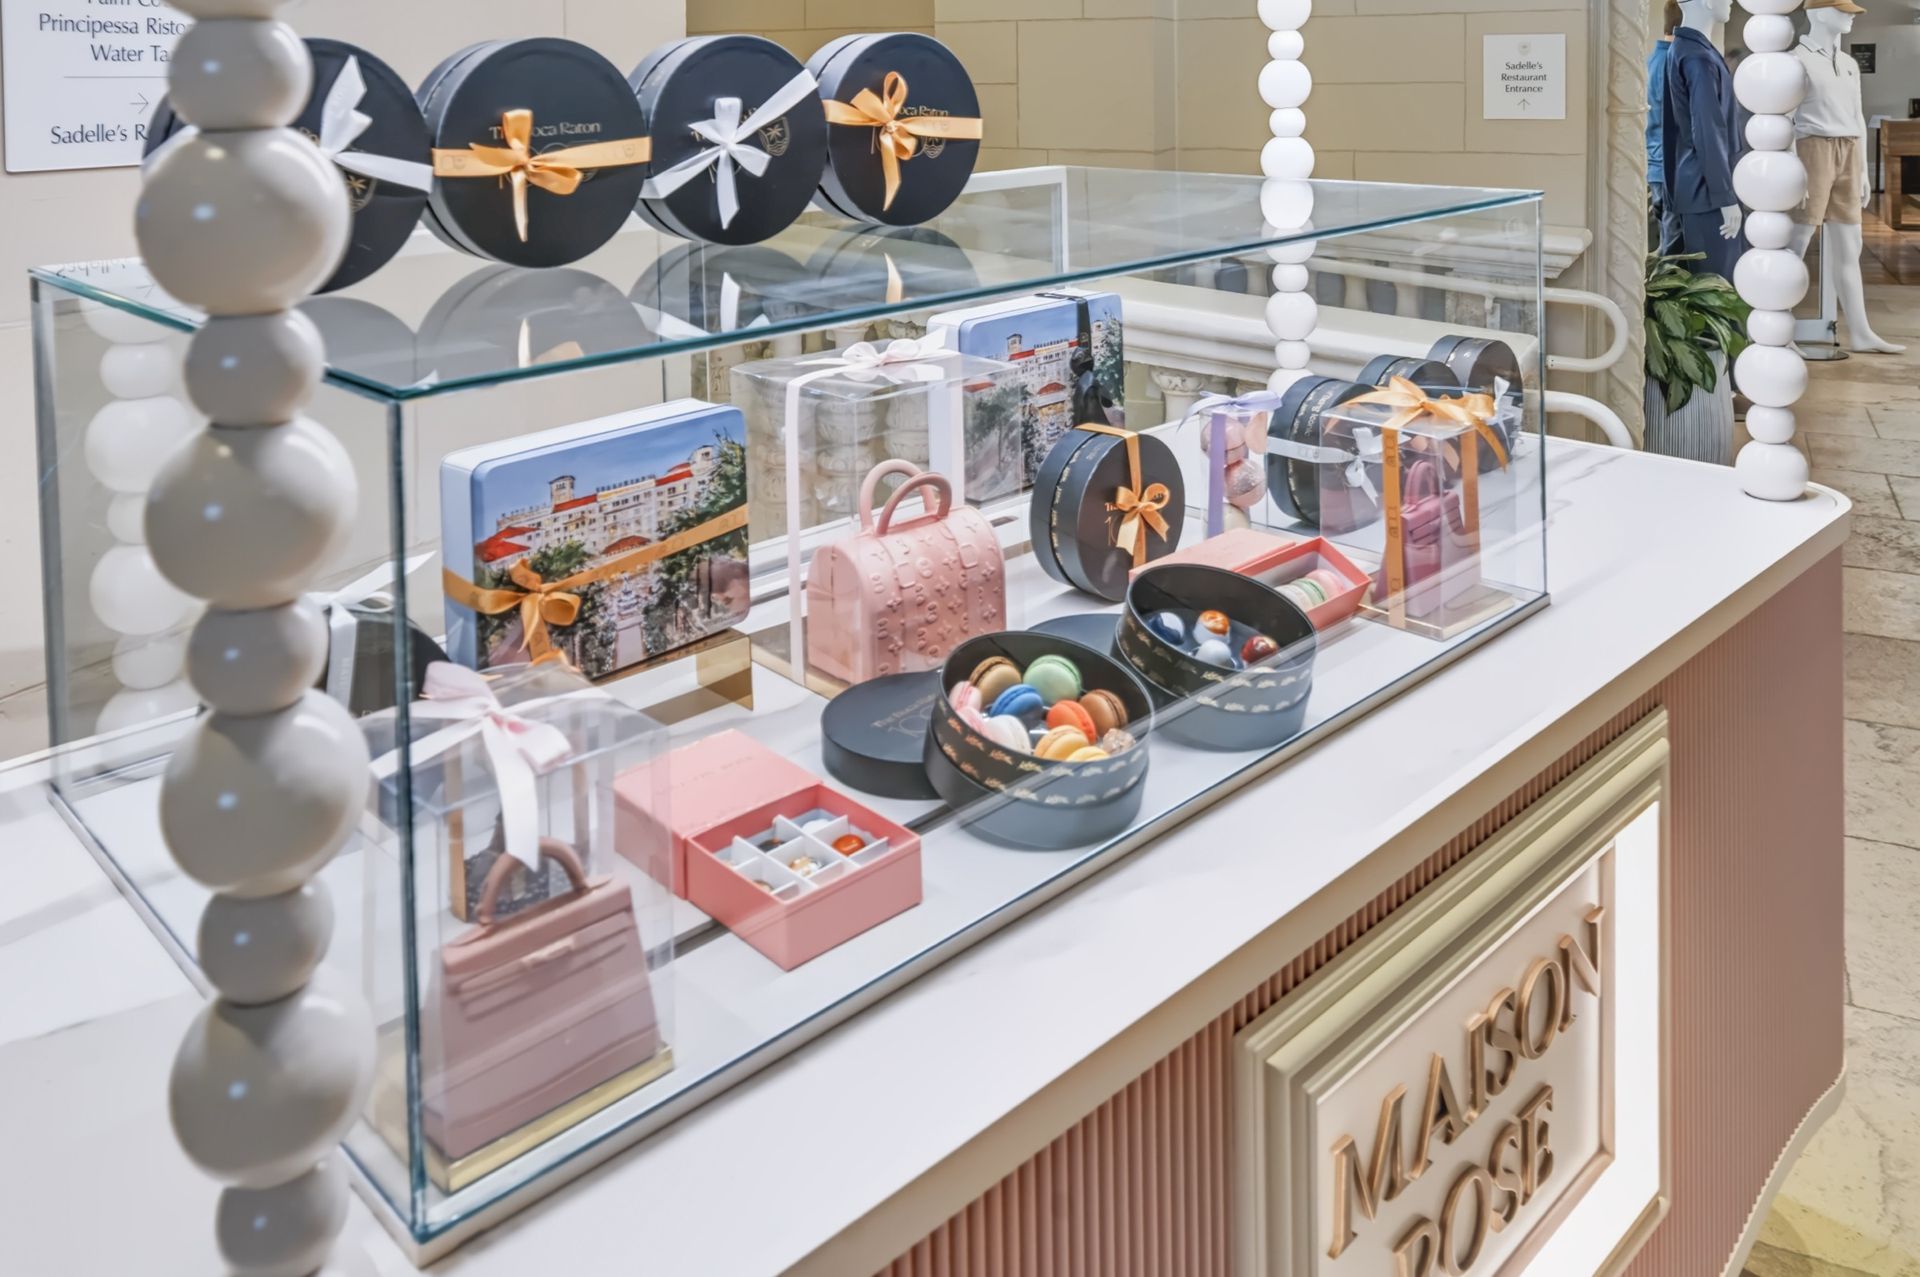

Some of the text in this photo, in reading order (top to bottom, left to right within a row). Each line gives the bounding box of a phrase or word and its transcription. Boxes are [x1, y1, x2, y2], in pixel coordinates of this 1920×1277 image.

[38, 13, 186, 38] Principessa Risto
[90, 44, 169, 62] Water Ta
[1500, 73, 1547, 82] Restaurant
[1505, 84, 1543, 93] Entrance
[899, 104, 918, 116] oca
[134, 123, 149, 141] R
[532, 125, 558, 137] oca
[559, 121, 601, 136] Raton
[1328, 905, 1605, 1260] MAISON
